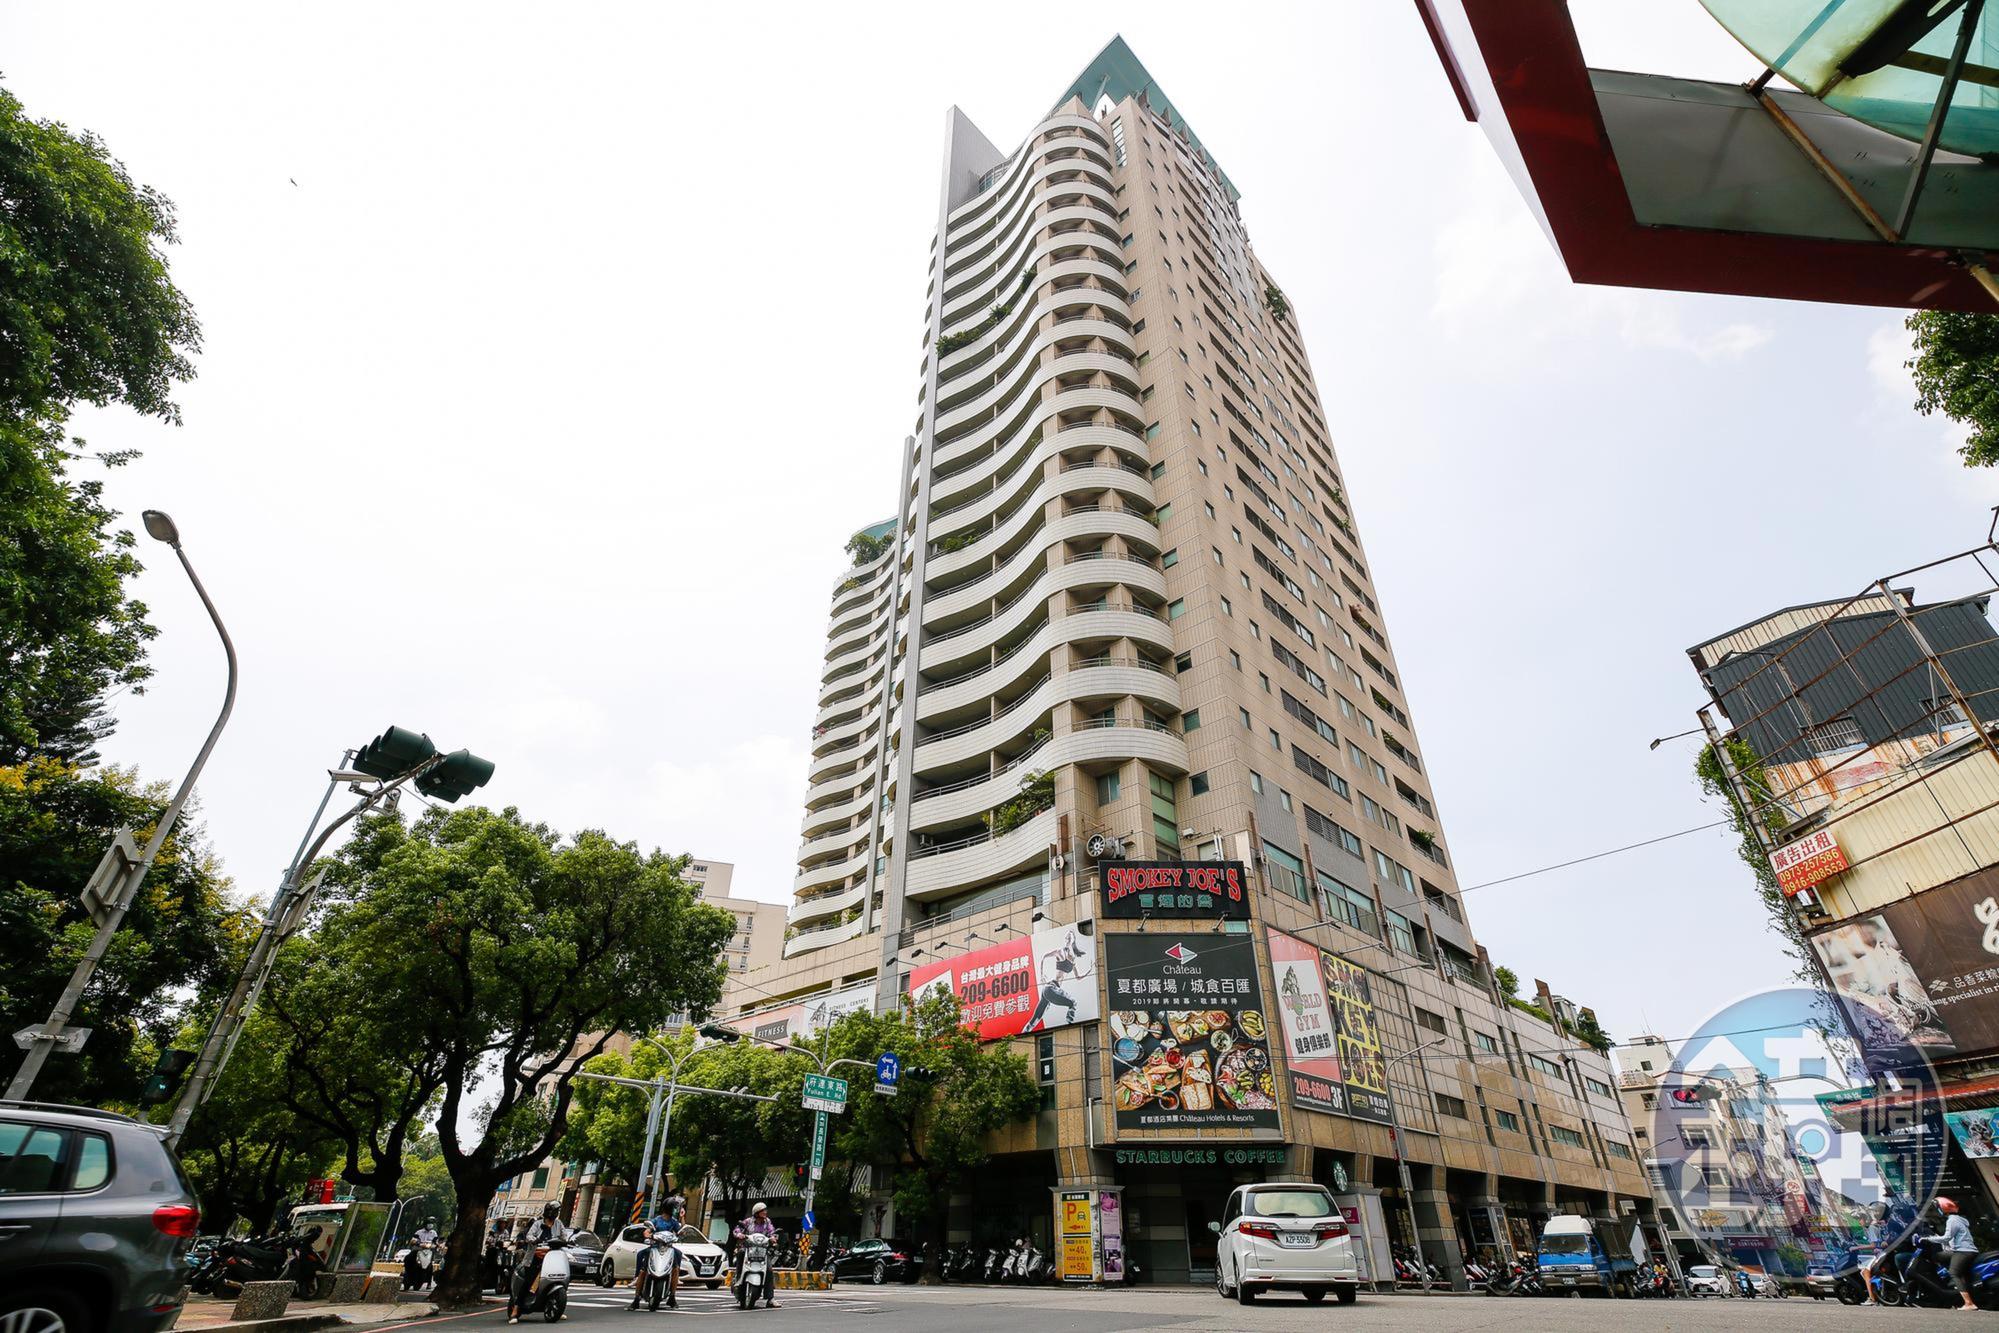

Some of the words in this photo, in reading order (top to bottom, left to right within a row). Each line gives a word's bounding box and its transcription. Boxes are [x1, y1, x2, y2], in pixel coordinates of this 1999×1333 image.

[1774, 832, 1832, 869] 廣告出租
[1780, 848, 1839, 882] 0973-257586
[1107, 868, 1183, 903] SMOKEY
[1187, 868, 1241, 901] JOE'S
[1785, 861, 1844, 894] 0916-908553
[960, 956, 1030, 984] 台灣最大健身品牌
[1163, 964, 1202, 975] Château
[960, 970, 1030, 1005] 209-6600
[1117, 978, 1178, 994] 夏都廣場
[1190, 978, 1251, 994] 城食百匯
[1948, 988, 1984, 1004] specialist
[960, 994, 1031, 1025] 歡迎免費參觀
[757, 1025, 785, 1038] FITNESS
[1295, 1013, 1321, 1032] GYM
[1294, 1033, 1331, 1054] 健身俱樂部
[810, 1077, 843, 1091] 府連東路
[1294, 1077, 1331, 1101] 209-6600
[1331, 1086, 1343, 1109] 3F
[1206, 1113, 1226, 1122] Hotels
[1232, 1113, 1255, 1122] Resorts
[1116, 1150, 1217, 1164] STARBUCKS
[1223, 1149, 1287, 1164] COFFEE
[1066, 1202, 1077, 1221] P
